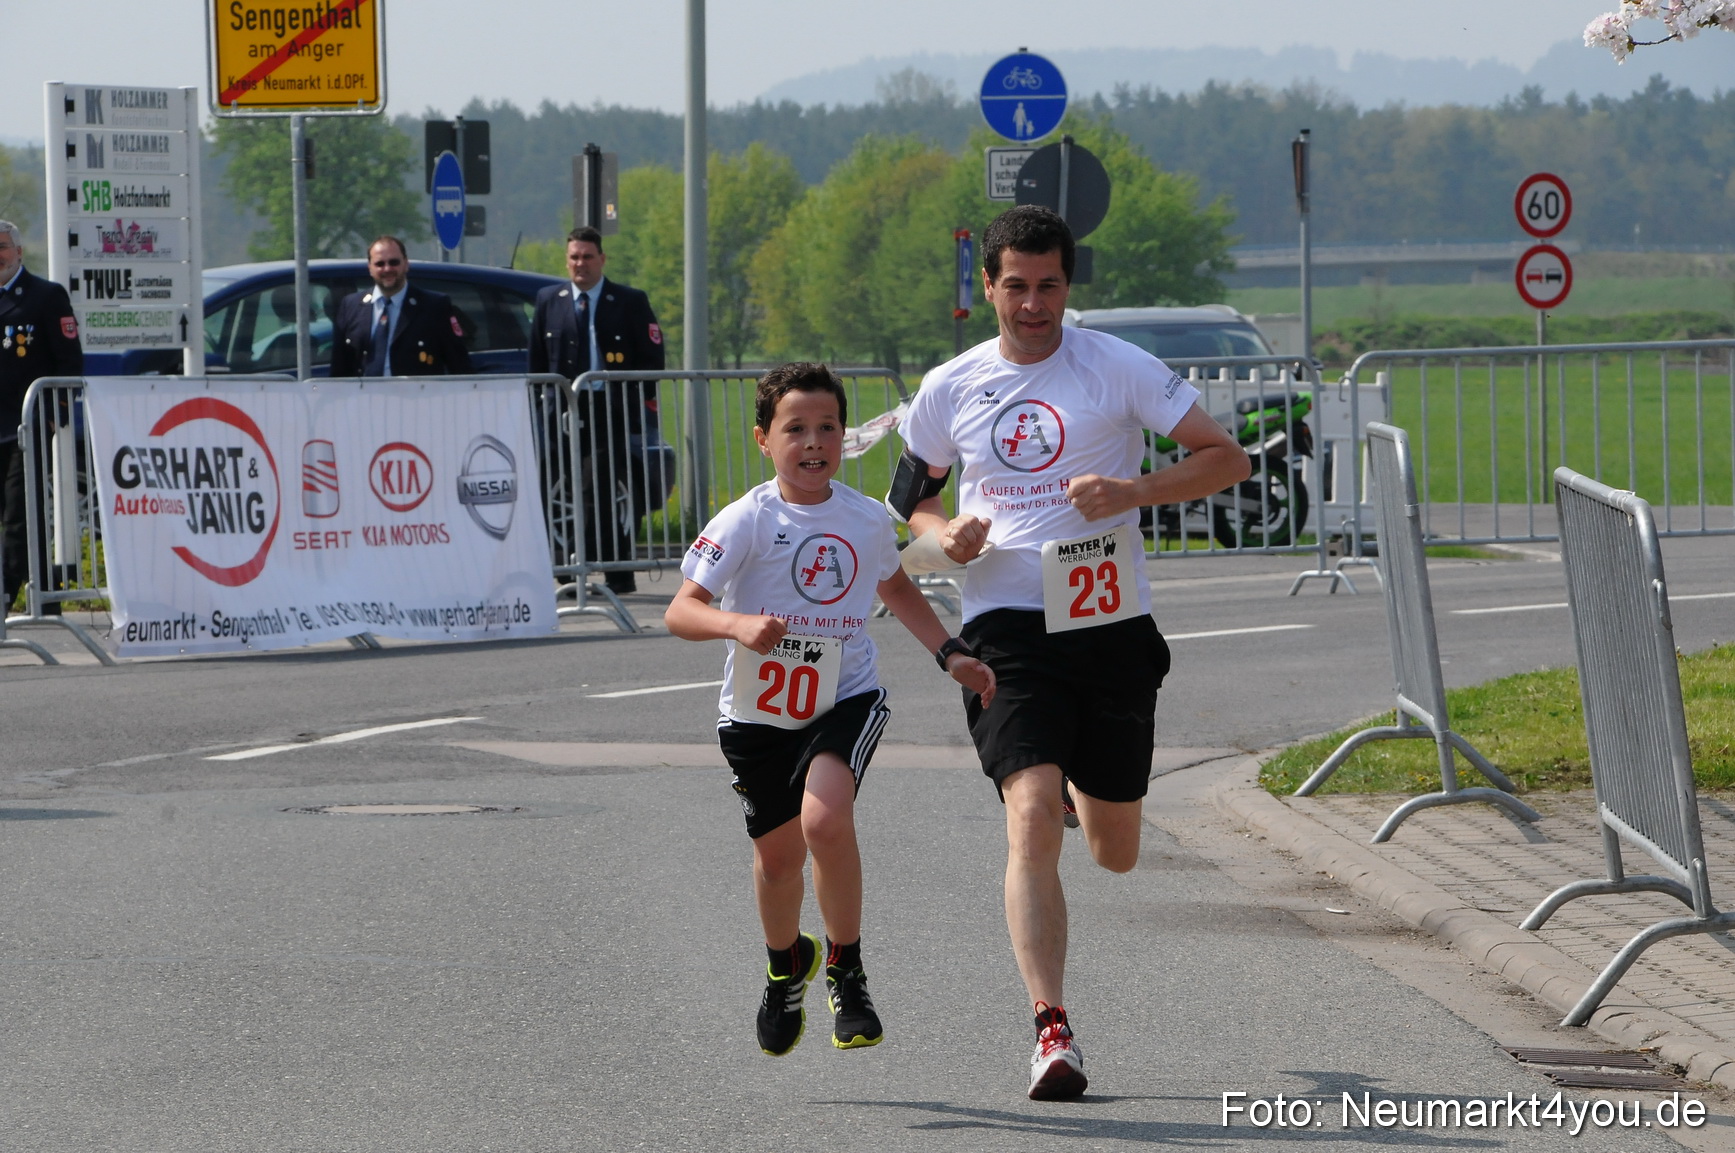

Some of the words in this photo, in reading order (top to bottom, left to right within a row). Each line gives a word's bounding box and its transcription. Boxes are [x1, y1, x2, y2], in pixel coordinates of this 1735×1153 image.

[230, 0, 362, 38] Sengenthal
[248, 44, 277, 58] am
[287, 40, 344, 62] Anger
[228, 76, 258, 91] Kreis
[263, 75, 321, 90] Neumarkt
[111, 89, 168, 110] HOLZAMMER
[112, 133, 170, 153] HOLZAMMER
[995, 168, 1018, 180] scha
[82, 180, 112, 213] SHB
[113, 185, 171, 208] Holzfachmarkt
[995, 182, 1016, 194] Verk
[1528, 190, 1560, 220] 60
[83, 269, 132, 300] THULE
[112, 445, 243, 490] GERHART
[248, 457, 259, 479] &
[379, 459, 423, 495] KIA
[113, 493, 186, 516] Autohaus
[186, 491, 266, 534] JÄNIG
[993, 502, 1004, 511] Dr.
[1005, 501, 1026, 511] Heck
[1035, 499, 1049, 509] Dr.
[293, 531, 352, 550] SEAT
[362, 525, 387, 547] KIA
[390, 523, 451, 547] MOTORS
[1058, 539, 1101, 556] MEYER
[1058, 549, 1102, 564] WERBUNG
[1069, 560, 1121, 619] 23
[121, 612, 197, 642] eumarkt
[210, 607, 287, 644] Sengenthal
[842, 616, 866, 629] HER
[756, 660, 819, 721] 20
